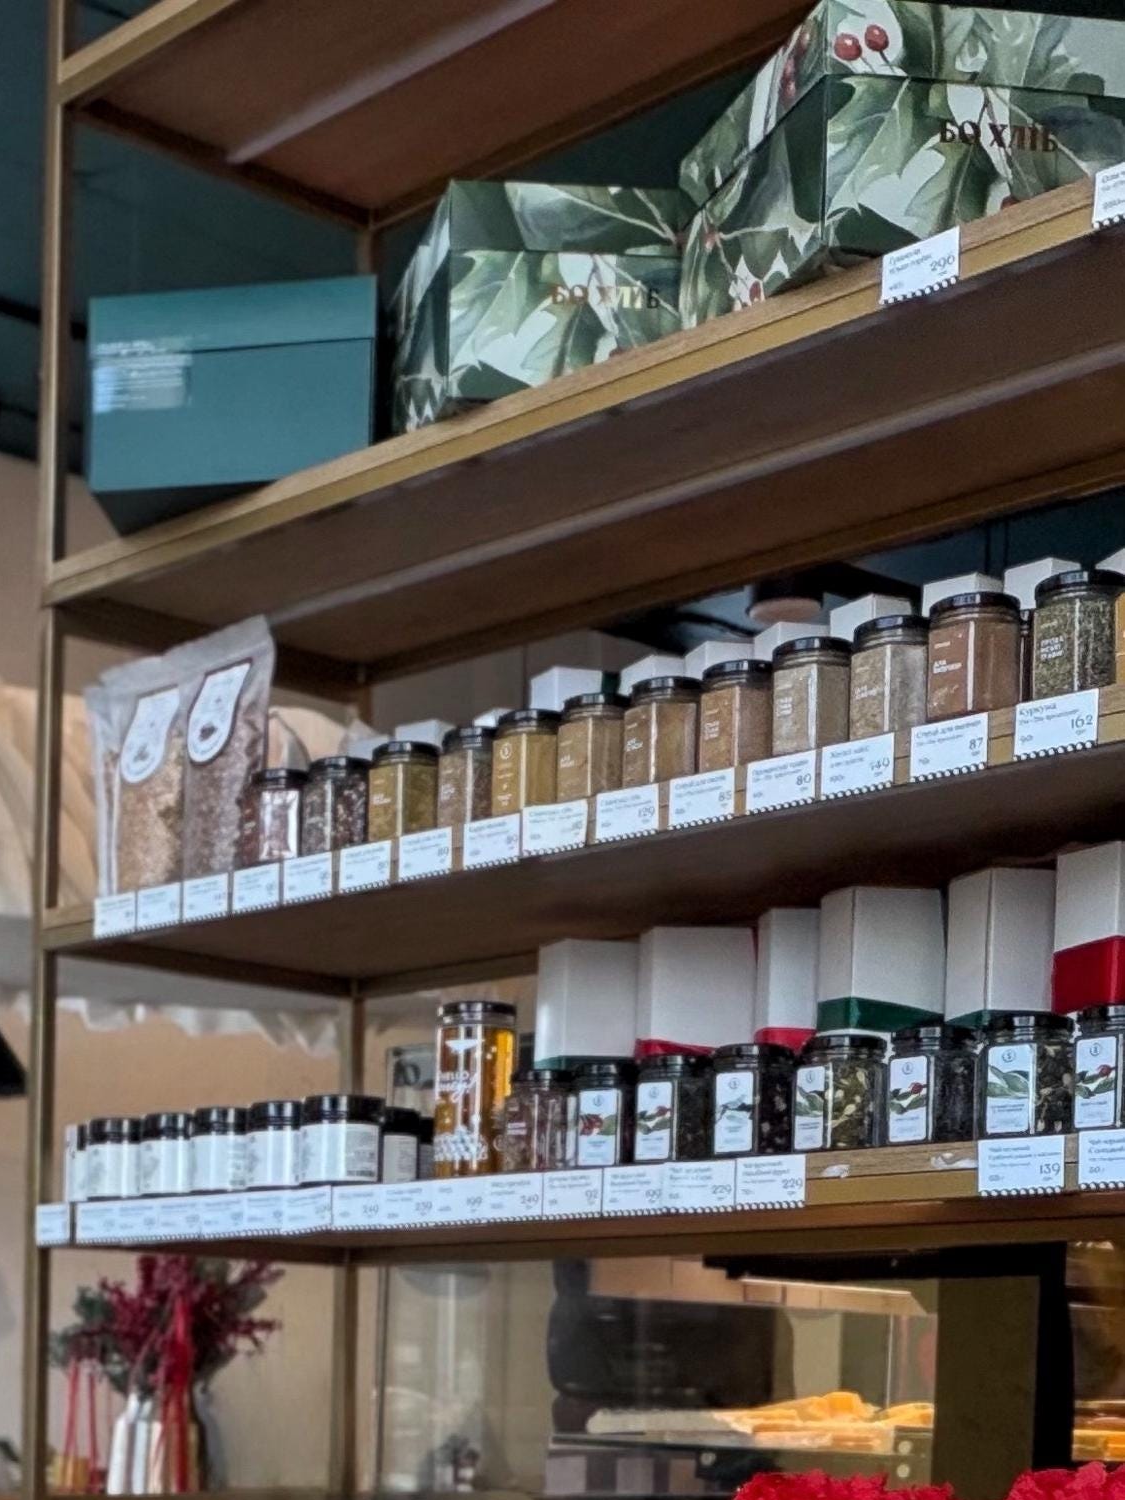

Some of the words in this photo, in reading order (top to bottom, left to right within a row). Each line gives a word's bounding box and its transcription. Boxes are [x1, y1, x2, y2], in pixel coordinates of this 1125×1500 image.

[1070, 714, 1093, 730] 162
[969, 736, 984, 751] 87
[796, 773, 812, 786] 80
[1039, 1162, 1061, 1176] 139
